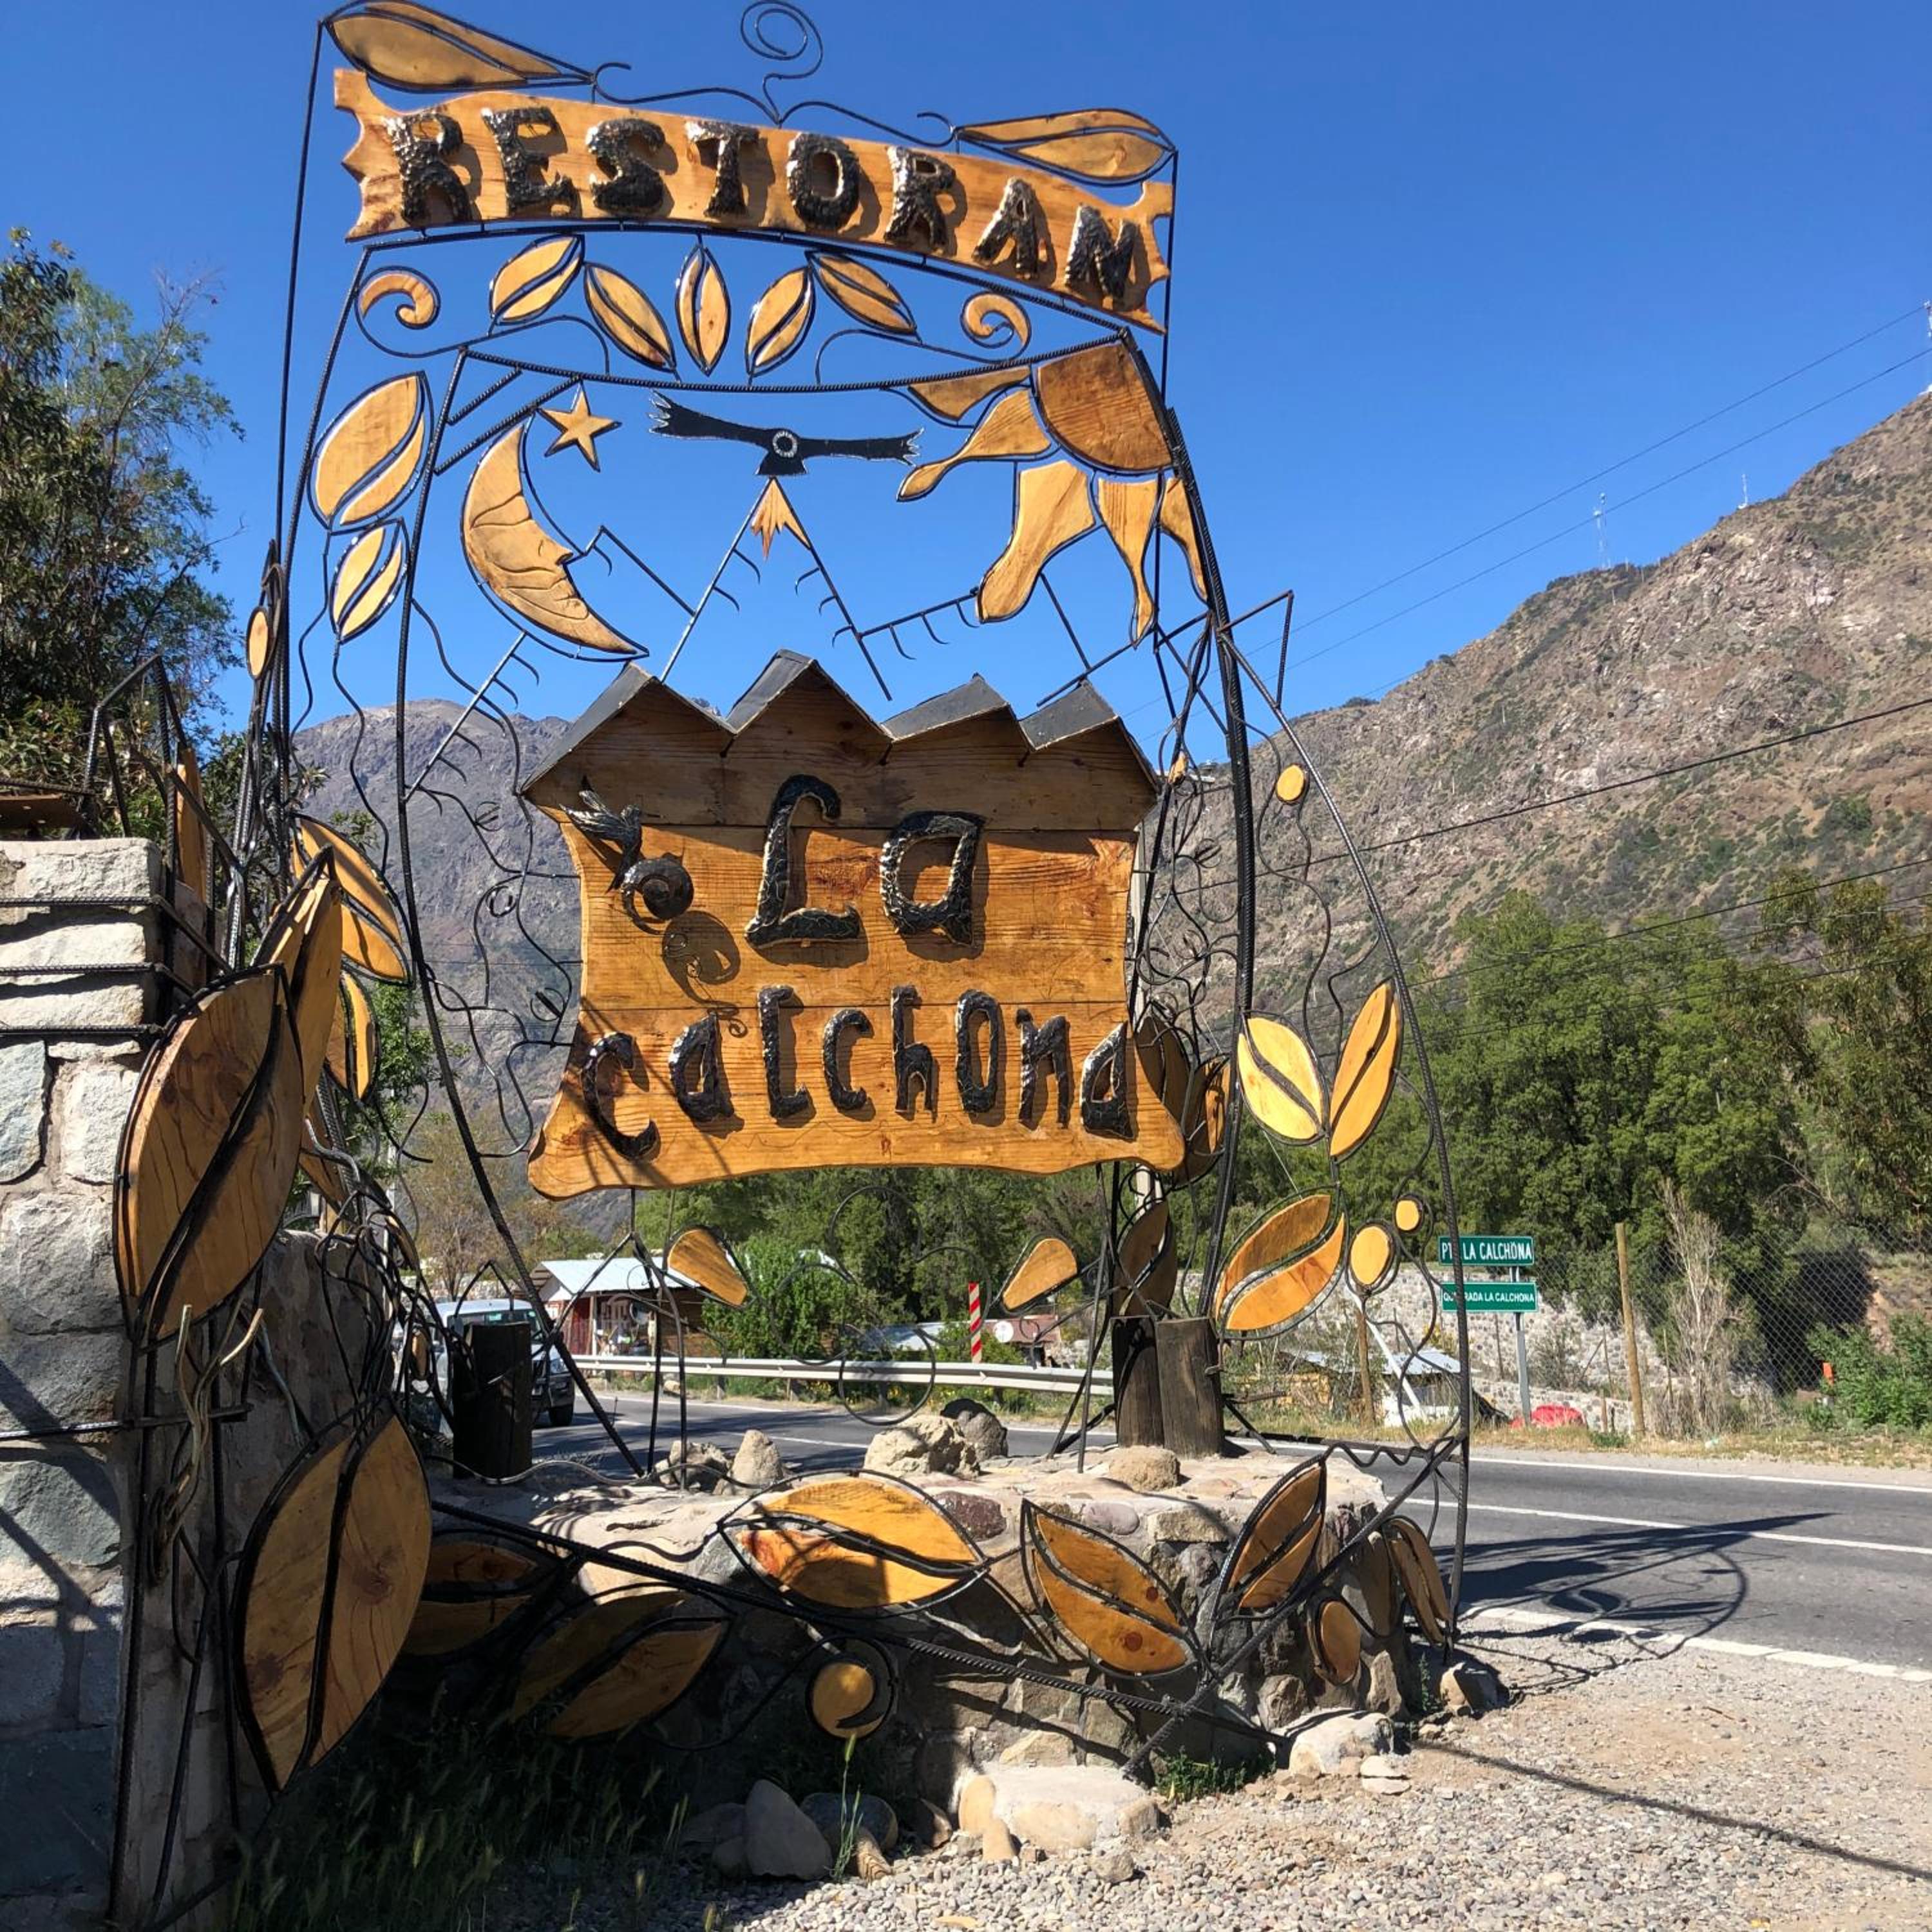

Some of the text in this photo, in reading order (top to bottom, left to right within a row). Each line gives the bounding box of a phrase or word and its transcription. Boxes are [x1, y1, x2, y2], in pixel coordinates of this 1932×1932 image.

[383, 106, 1148, 300] RESTORAN
[745, 773, 986, 949] La
[1443, 1292, 1534, 1302] QRADA LA CALCHONA
[1463, 1242, 1476, 1260] LA
